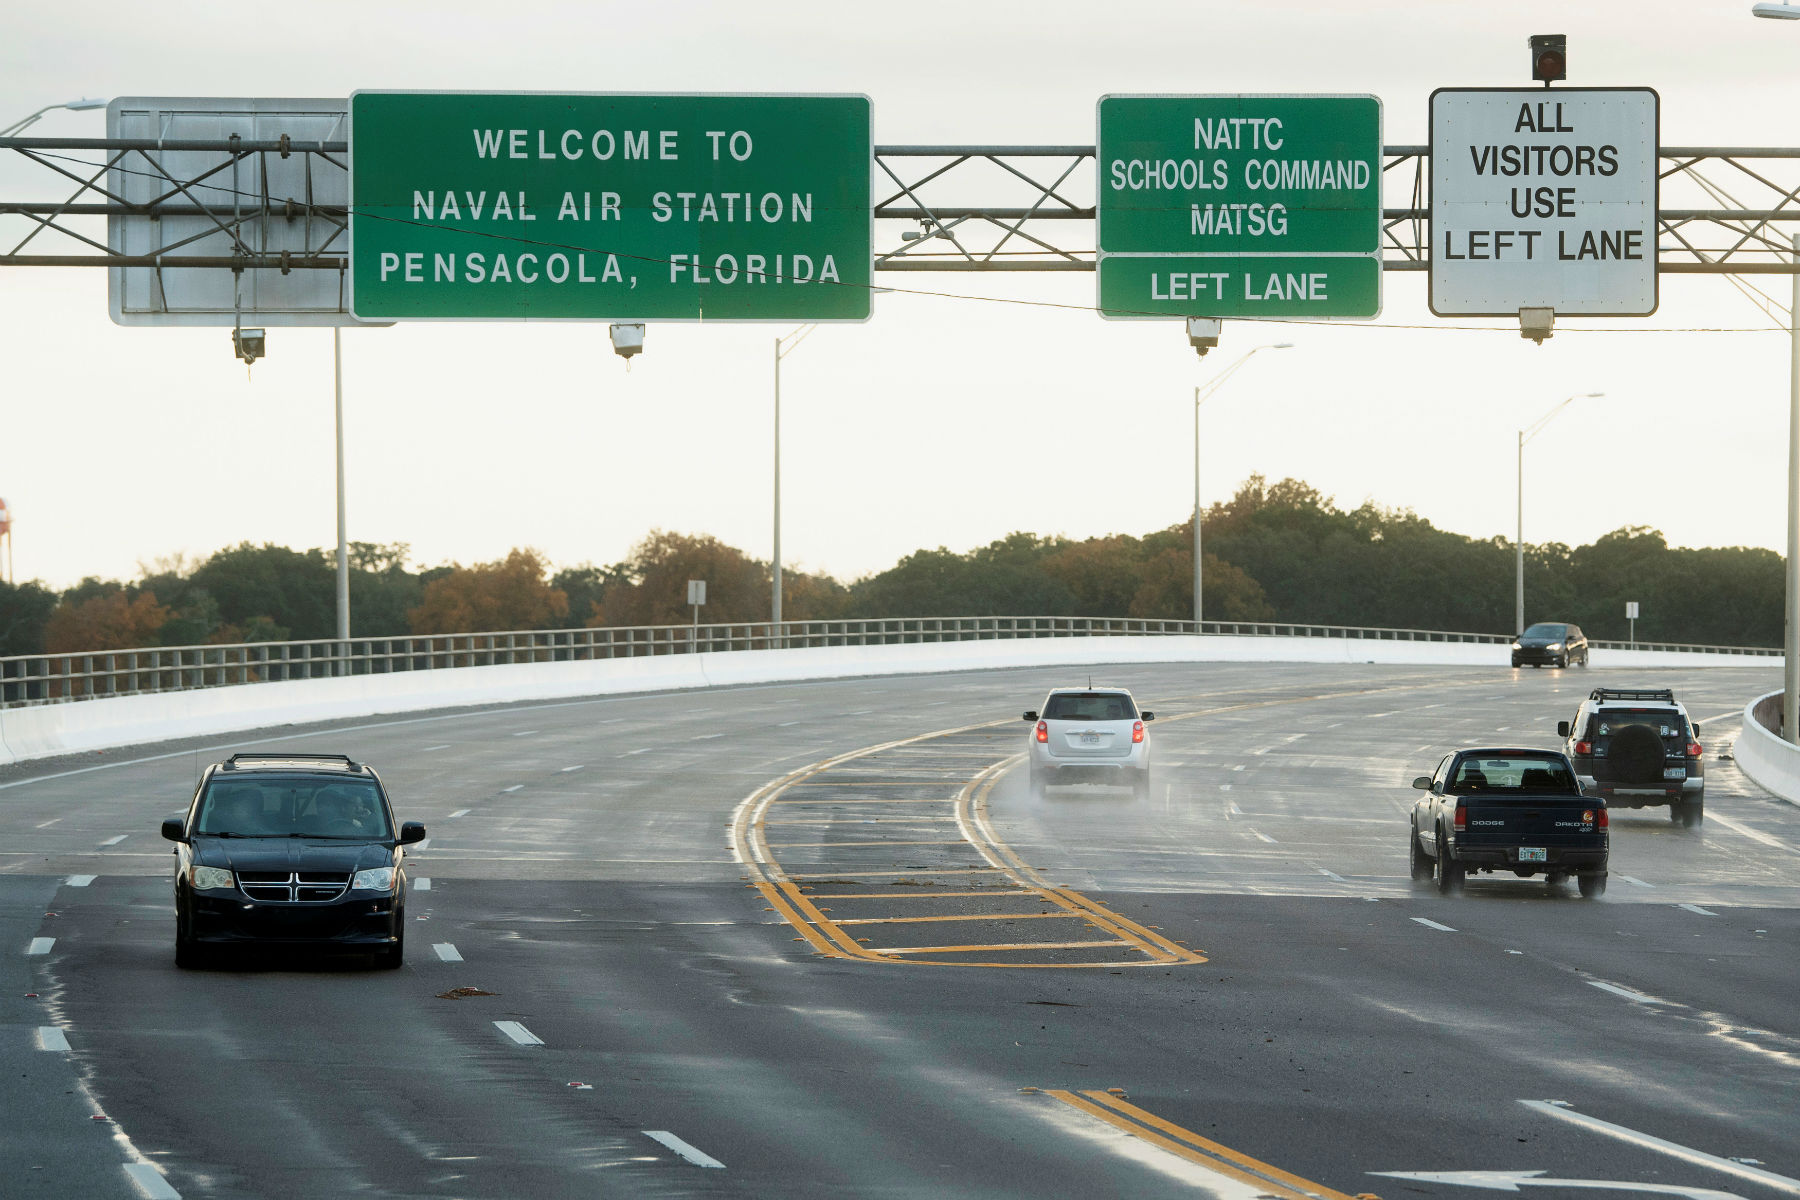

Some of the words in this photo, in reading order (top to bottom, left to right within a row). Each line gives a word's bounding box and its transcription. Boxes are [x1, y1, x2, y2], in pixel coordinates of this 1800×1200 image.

[1194, 117, 1284, 151] NATTC
[1515, 103, 1573, 133] ALL
[473, 129, 678, 161] WELCOME
[705, 130, 753, 162] TO
[1469, 144, 1619, 177] VISITORS
[1110, 159, 1228, 191] SCHOOLS
[1245, 159, 1370, 190] COMMAND
[413, 190, 536, 221] NAVAL
[557, 191, 621, 221] AIR
[652, 191, 812, 223] STATION
[1191, 202, 1288, 236] MATSG
[1510, 186, 1576, 219] USE
[1445, 230, 1542, 260] LEFT
[1558, 230, 1643, 261] LANE
[380, 252, 637, 289] PENSACOLA,
[670, 253, 841, 285] FLORIDA
[1151, 272, 1230, 300] LEFT
[1244, 273, 1328, 301] LANE
